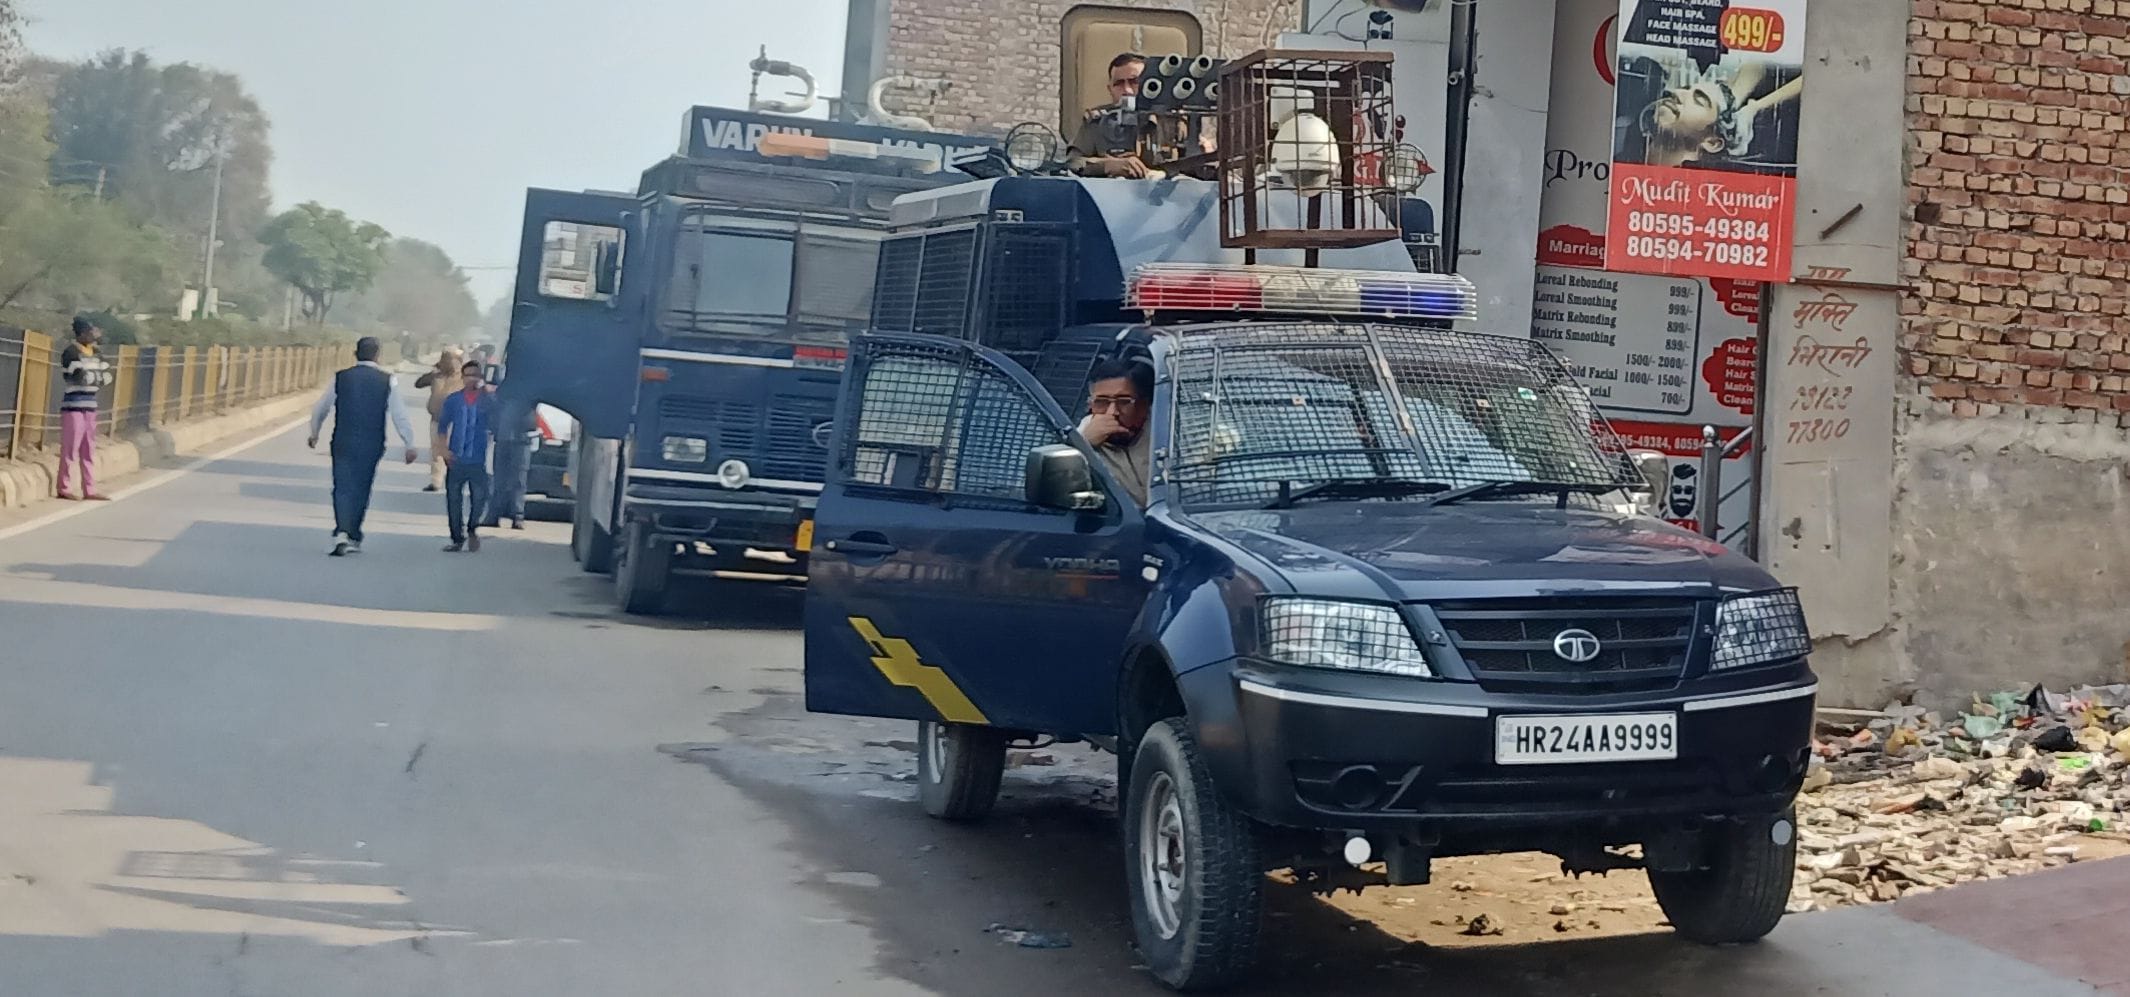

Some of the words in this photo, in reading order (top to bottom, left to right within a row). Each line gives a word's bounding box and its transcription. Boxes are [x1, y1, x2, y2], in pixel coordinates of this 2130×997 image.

[1661, 7, 1683, 17] HAIR
[1647, 19, 1671, 30] FACE
[1672, 22, 1717, 34] MASSAGE
[1723, 13, 1781, 51] 499/-
[1646, 33, 1671, 43] HEAD
[1673, 35, 1717, 48] MASSAGE
[702, 118, 813, 153] VAR
[1545, 149, 1609, 188] Pro
[1621, 176, 1691, 206] Mudit
[1698, 183, 1779, 216] Kumar
[1628, 211, 1770, 242] 80595-49384
[1627, 235, 1768, 267] 80594-70982
[1569, 275, 1618, 293] Rebonding
[1567, 293, 1617, 311] Smoothing
[1567, 311, 1617, 329] Rebonding
[1565, 329, 1616, 346] Smoothing
[1727, 344, 1750, 354] Hair
[1589, 367, 1618, 380] Facial
[1725, 369, 1748, 379] Hair
[1724, 382, 1754, 392] Matrix
[1516, 723, 1672, 753] HR24AA9999
